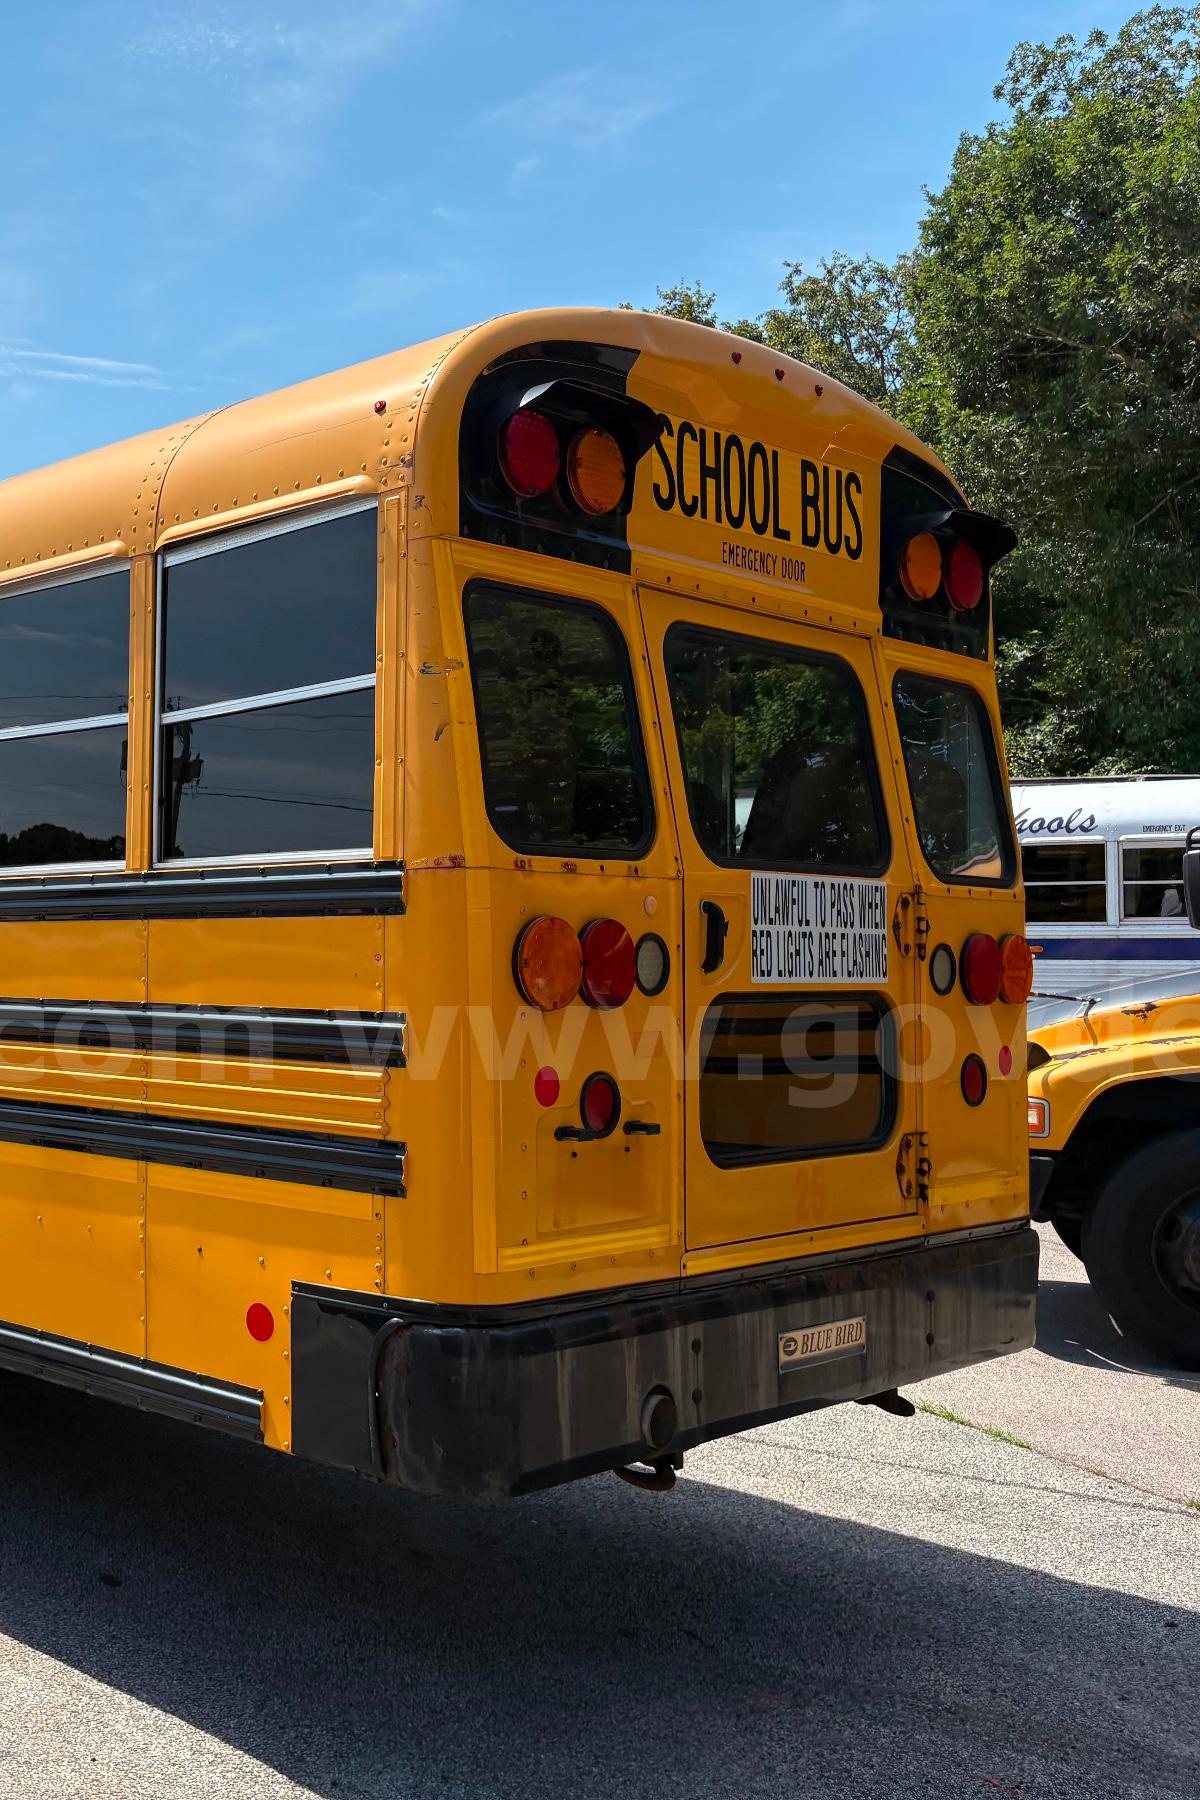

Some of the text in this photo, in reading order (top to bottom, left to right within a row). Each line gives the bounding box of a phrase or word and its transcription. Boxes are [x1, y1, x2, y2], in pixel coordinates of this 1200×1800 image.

[652, 412, 863, 561] SCHOOL BUS
[721, 541, 806, 584] EMERGENCY DOOR
[1142, 824, 1186, 833] EMERGENCY EXIT
[752, 877, 886, 930] UNLAWFUL TO PASS WHEN
[752, 929, 888, 979] RED LIGHTS ARE FLASHING
[800, 1321, 863, 1355] BLUE BIRD
